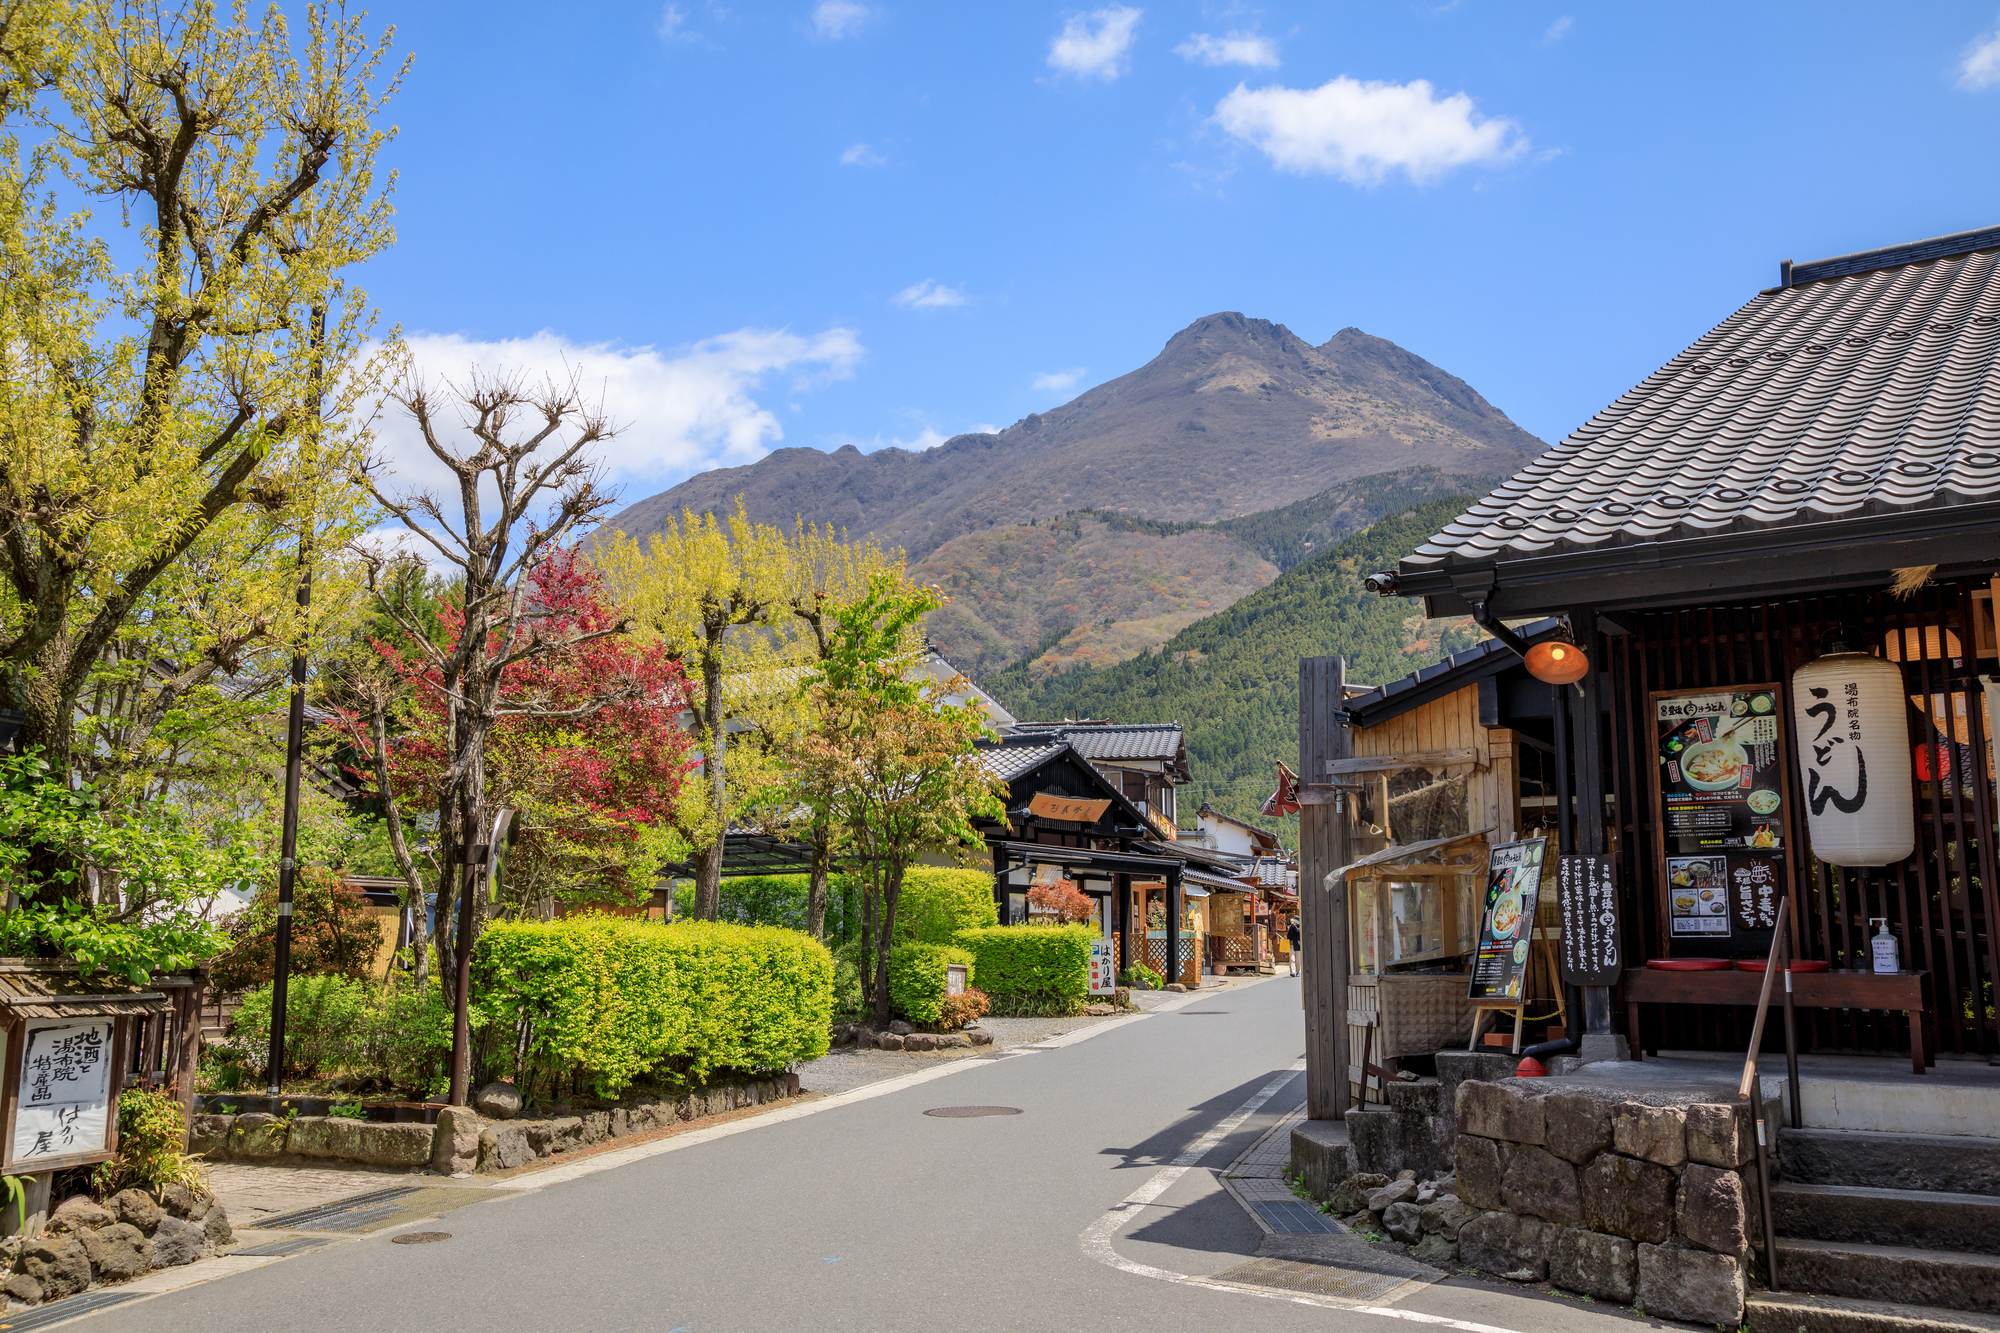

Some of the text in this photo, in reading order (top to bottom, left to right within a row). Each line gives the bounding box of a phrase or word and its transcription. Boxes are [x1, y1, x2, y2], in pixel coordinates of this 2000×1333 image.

[1844, 683, 1861, 740] 湯布院名物
[1805, 687, 1867, 816] うどん
[1757, 884, 1775, 927] 中毒になる
[1091, 961, 1099, 990] 駐車場
[1100, 945, 1112, 988] はかり屋
[51, 1037, 79, 1082] 湯布院
[74, 1026, 103, 1074] 地酒と
[29, 1054, 52, 1102] 特産品
[23, 1130, 59, 1157] 屋
[58, 1105, 80, 1146] はかり
